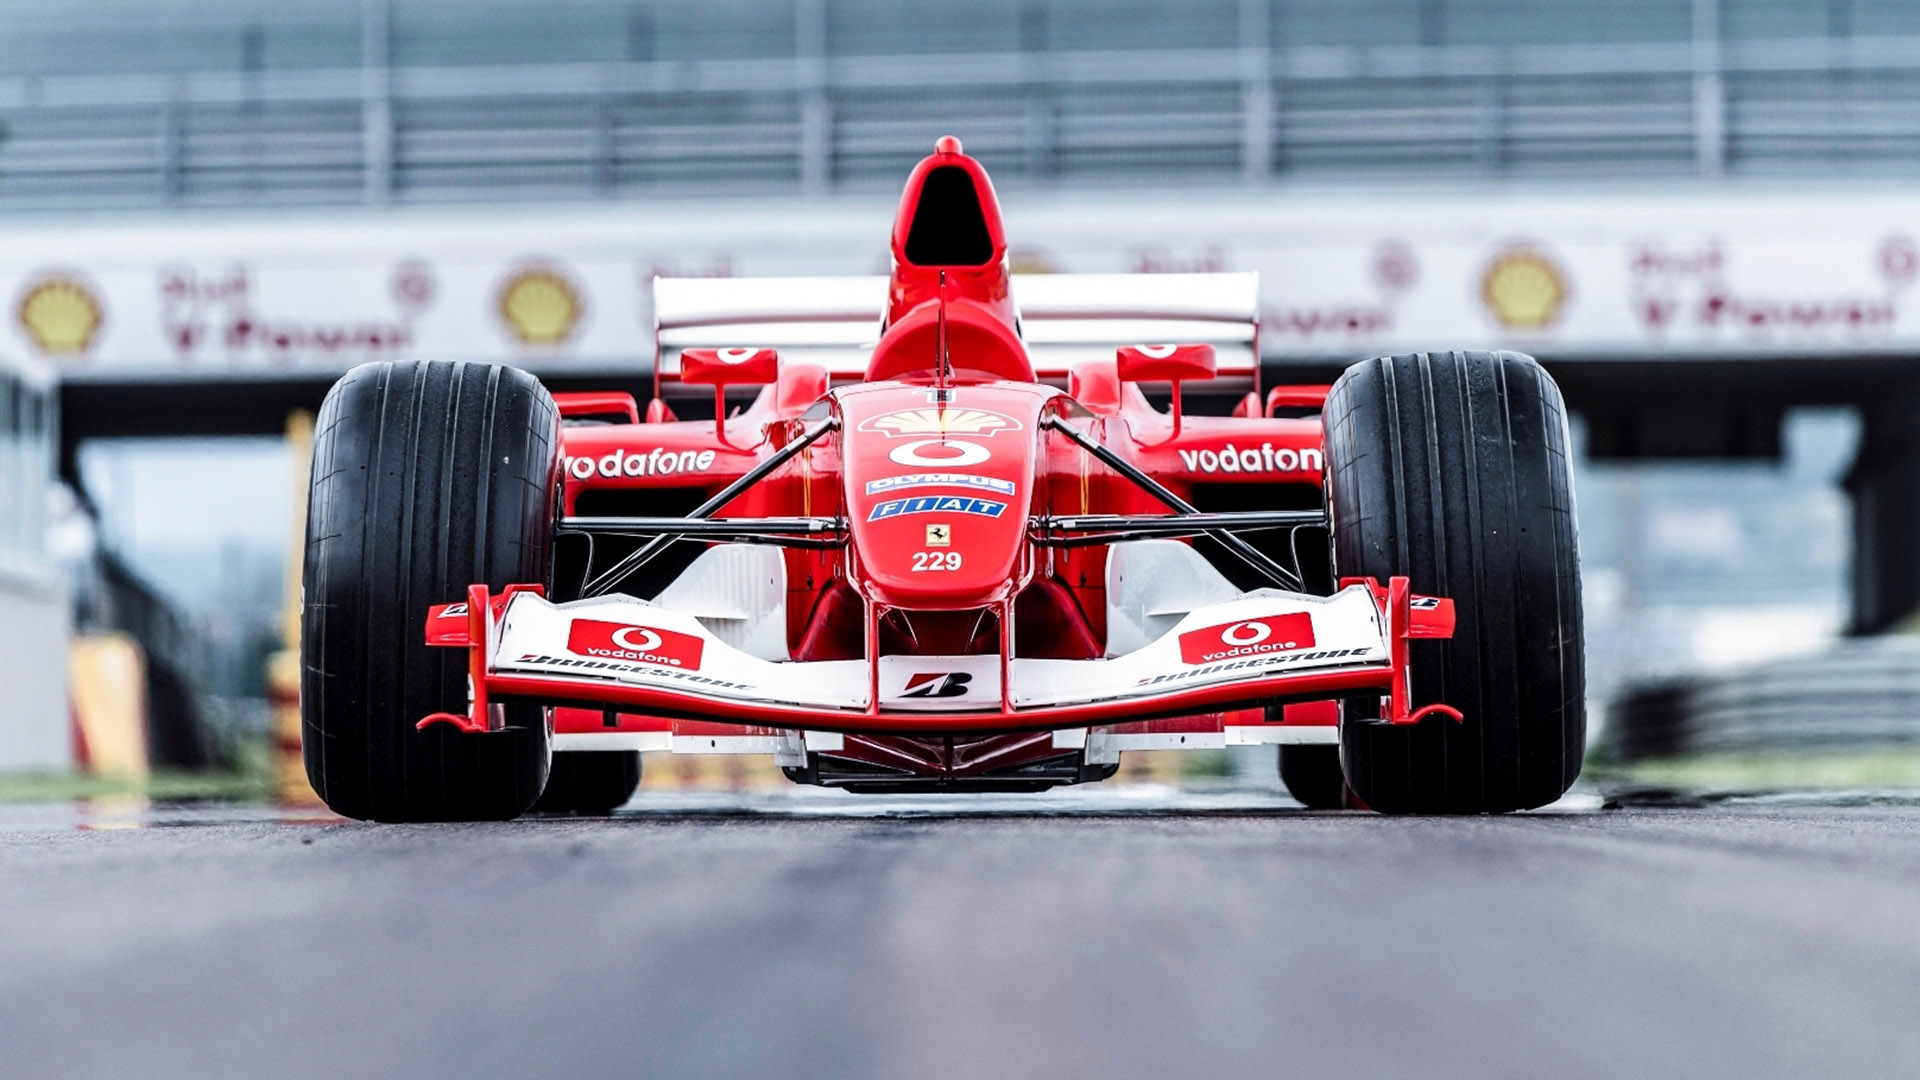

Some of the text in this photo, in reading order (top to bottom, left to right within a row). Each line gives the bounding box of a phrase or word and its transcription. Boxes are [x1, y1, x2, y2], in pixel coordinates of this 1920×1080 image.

[1178, 443, 1323, 473] vodafon
[870, 473, 1011, 489] OLYMPUS
[879, 498, 997, 516] FIAT
[911, 551, 963, 572] 229
[587, 646, 682, 667] vodafone
[1202, 641, 1297, 662] vodafone
[514, 654, 757, 691] BRIDGESTONE
[1136, 647, 1373, 687] BRIDGESTONE
